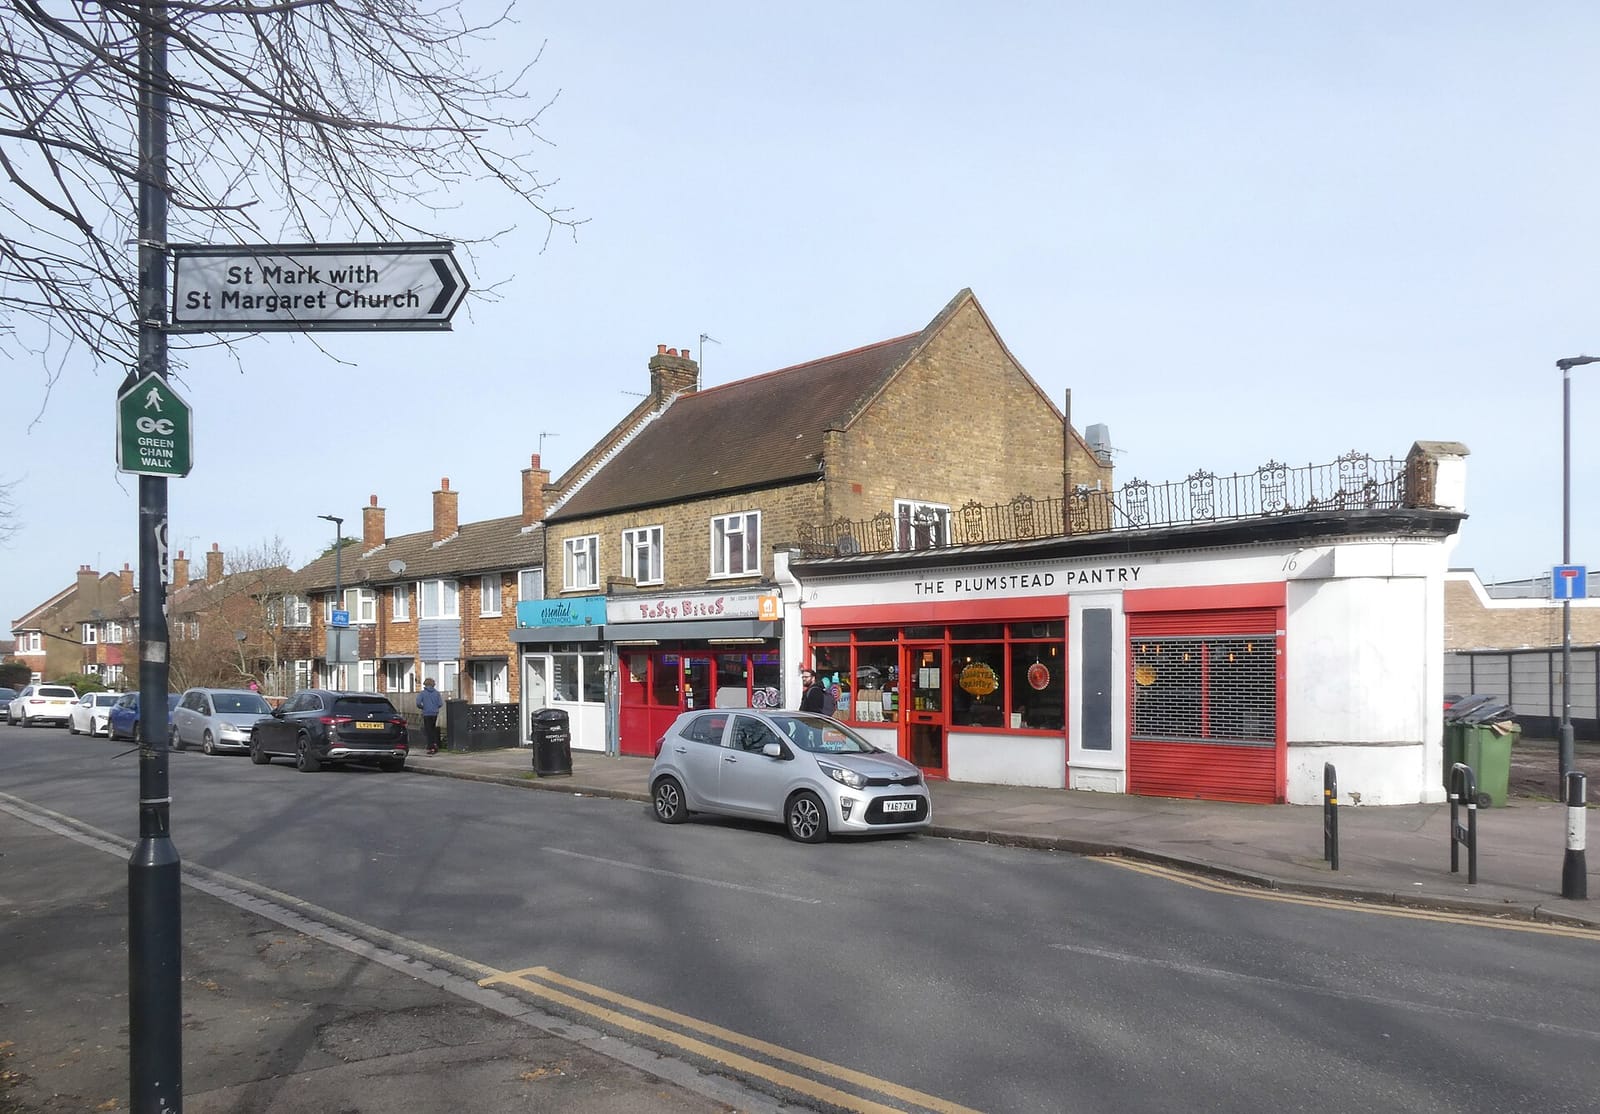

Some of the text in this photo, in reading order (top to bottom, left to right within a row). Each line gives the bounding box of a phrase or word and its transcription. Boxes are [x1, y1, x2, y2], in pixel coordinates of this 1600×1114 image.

[226, 265, 379, 285] St Mark with
[185, 289, 420, 313] St Margaret Church
[136, 416, 175, 435] GC
[138, 437, 175, 449] GREEN
[140, 447, 173, 458] CHAIN
[141, 457, 172, 468] WALK
[1281, 556, 1297, 572] 16
[914, 566, 1143, 595] THE PLUMSTEAD PANTRY
[541, 602, 571, 618] essential
